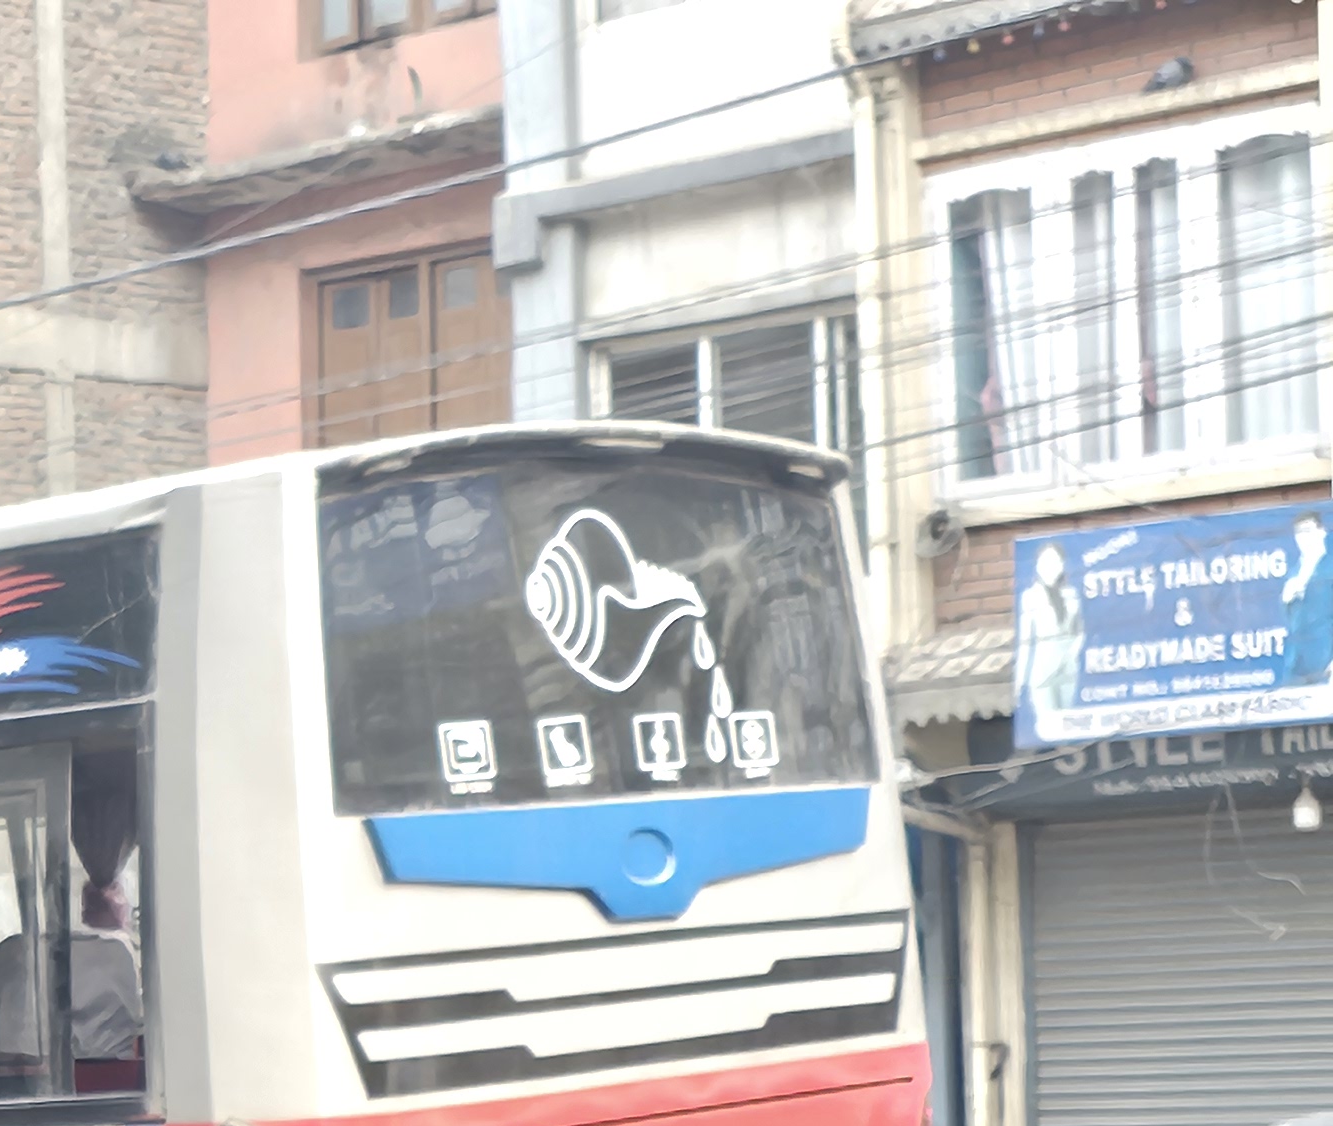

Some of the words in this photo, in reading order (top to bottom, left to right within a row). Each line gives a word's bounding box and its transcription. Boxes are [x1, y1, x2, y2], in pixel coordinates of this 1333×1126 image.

[1083, 564, 1155, 599] STYLE
[1160, 549, 1287, 591] TAILORING
[1174, 597, 1193, 626] &
[1085, 635, 1225, 674] READYMADE
[1232, 628, 1288, 659] SUIT
